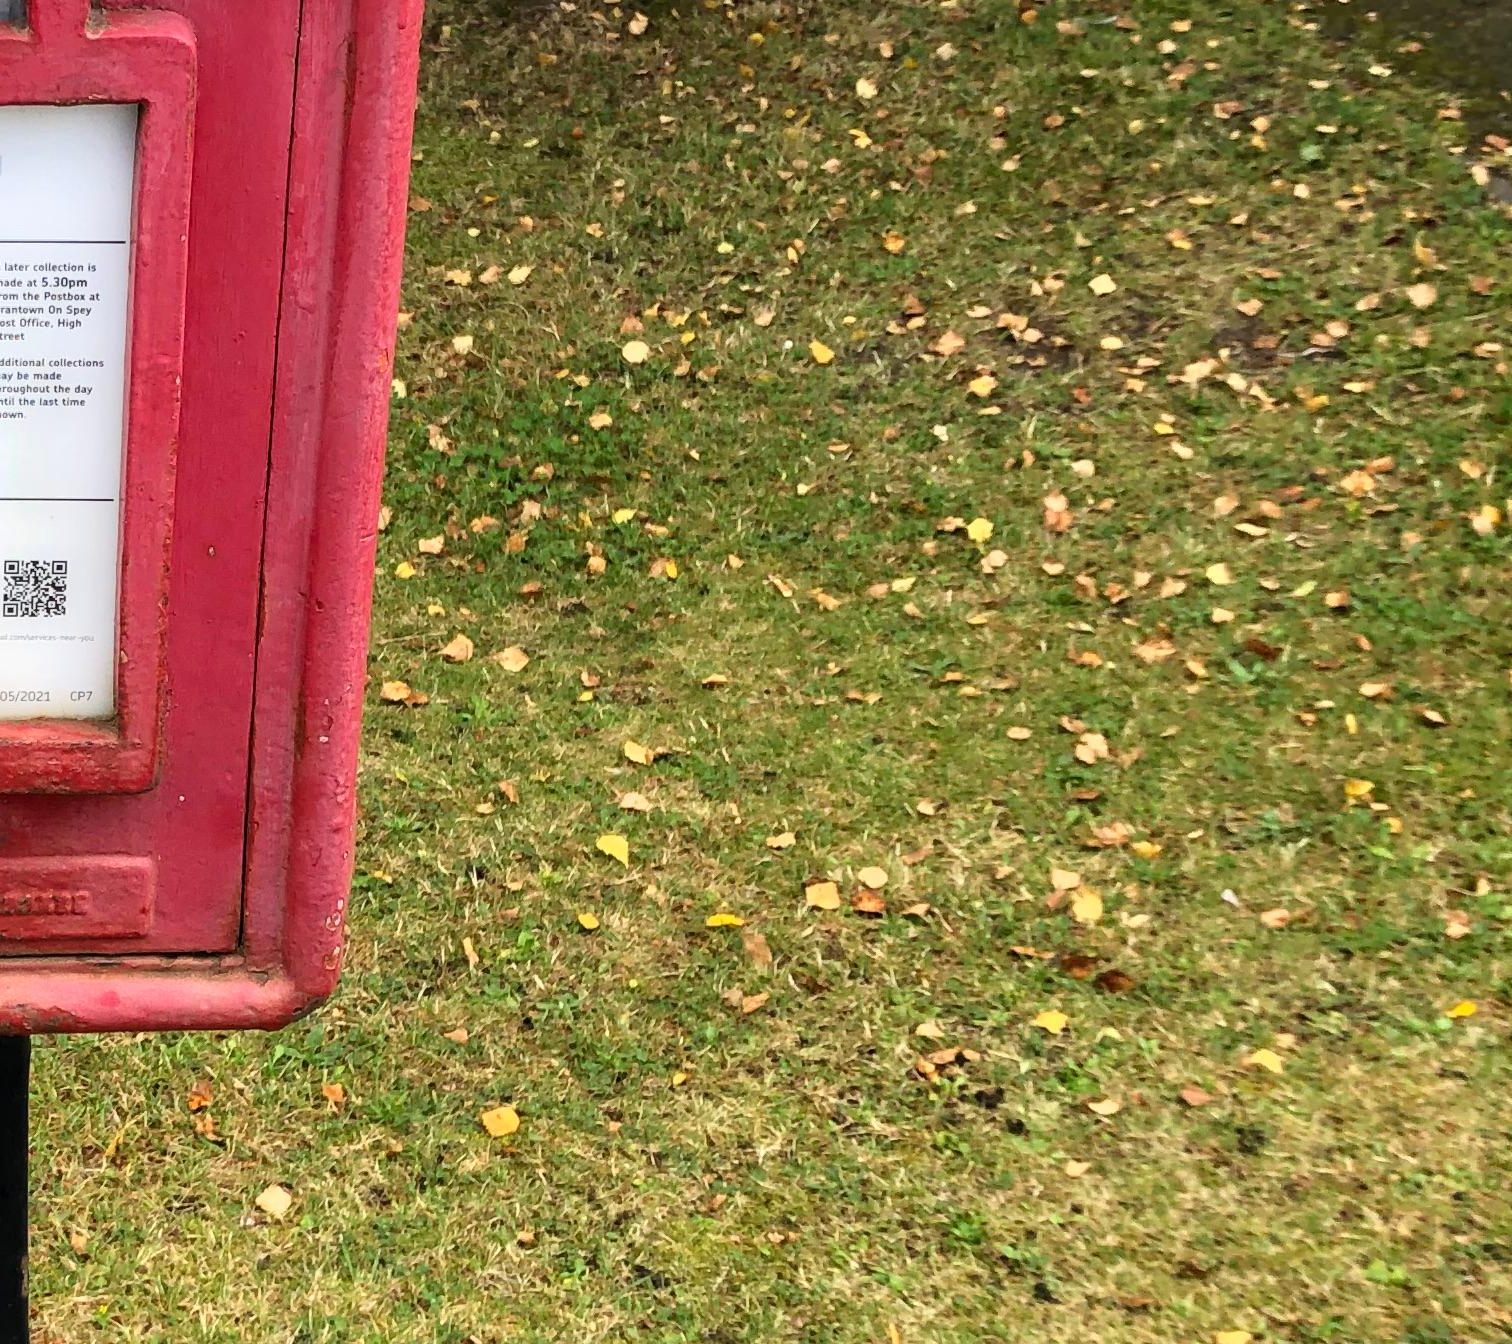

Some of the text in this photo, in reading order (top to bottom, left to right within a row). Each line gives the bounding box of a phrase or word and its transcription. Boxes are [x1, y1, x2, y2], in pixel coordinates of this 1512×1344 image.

[4, 262, 29, 272] later
[33, 261, 84, 272] collection
[88, 261, 97, 272] is
[26, 279, 37, 287] at
[41, 276, 88, 289] 5.30pm
[22, 291, 40, 301] the
[44, 291, 86, 302] Postbox
[89, 292, 100, 301] at
[48, 305, 63, 315] On
[66, 305, 92, 316] Spey
[19, 318, 54, 329] Office,
[57, 318, 82, 330] High
[48, 358, 104, 368] collections
[16, 371, 29, 381] be
[33, 371, 62, 381] made
[53, 384, 71, 394] the
[74, 384, 93, 395] day
[18, 397, 36, 407] the
[39, 397, 59, 407] last
[62, 397, 86, 407] time
[70, 690, 93, 701] CP7
